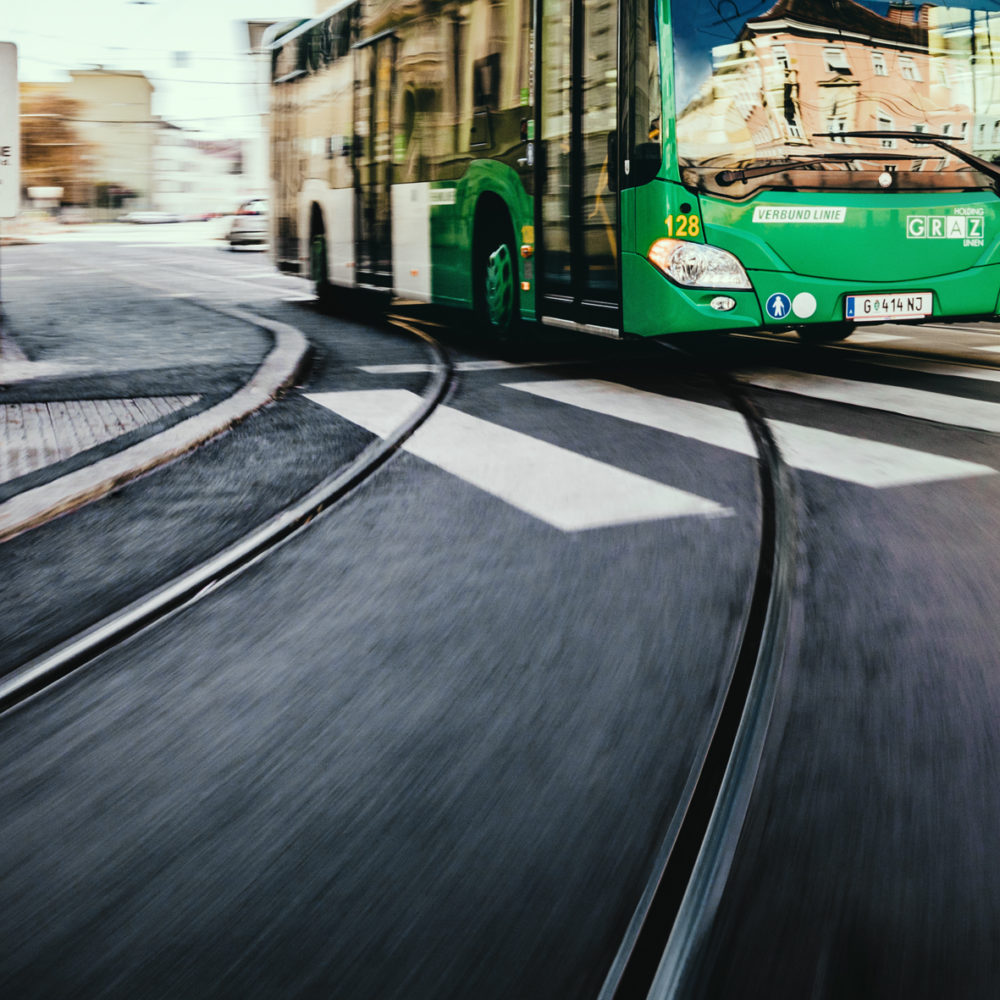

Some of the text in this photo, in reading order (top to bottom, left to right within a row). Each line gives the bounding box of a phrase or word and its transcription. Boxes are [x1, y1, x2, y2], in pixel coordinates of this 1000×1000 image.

[757, 208, 842, 221] VERBUND LINIE
[664, 214, 700, 237] 128
[907, 217, 983, 238] GRAZ
[863, 296, 923, 314] G 414 NJ
